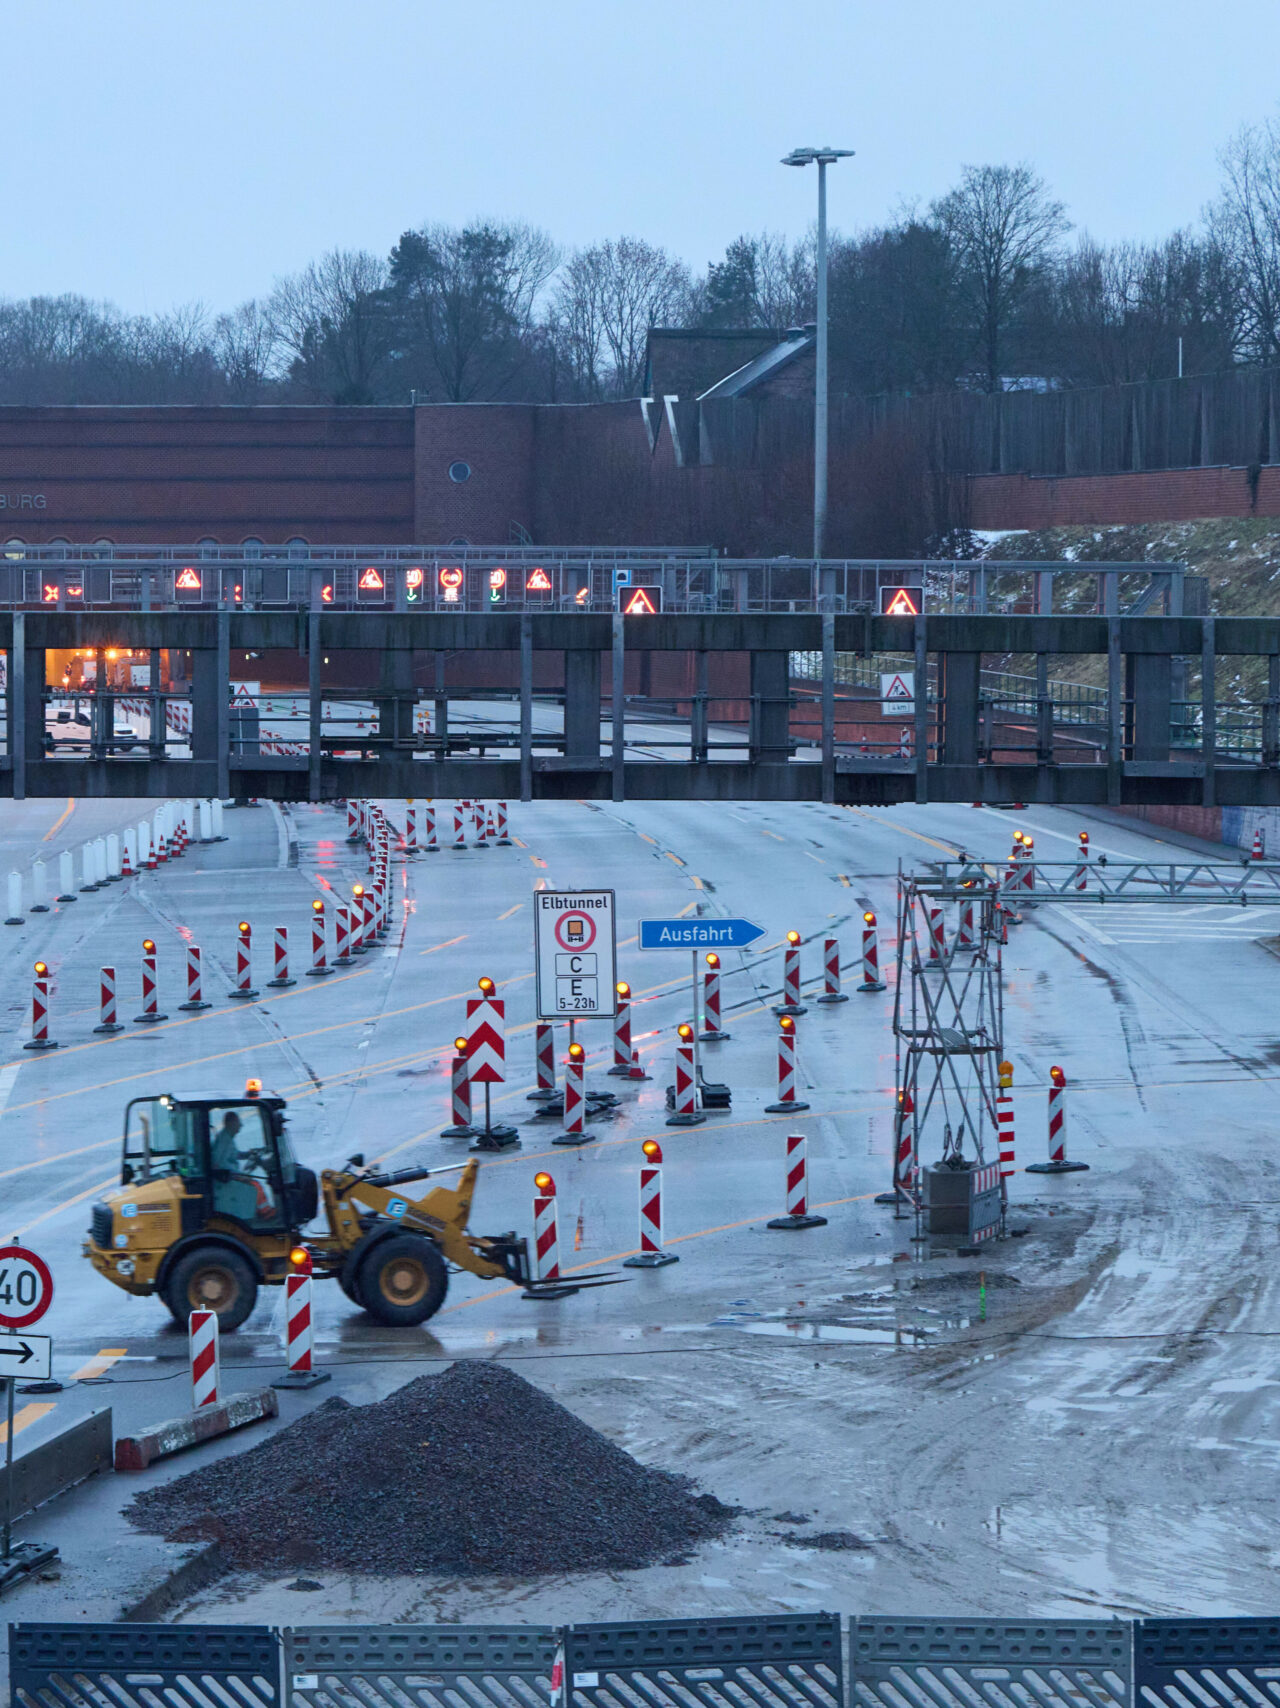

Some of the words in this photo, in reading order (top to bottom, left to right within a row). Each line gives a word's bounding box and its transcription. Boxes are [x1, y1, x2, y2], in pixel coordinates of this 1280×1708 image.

[542, 896, 608, 910] Elbtunnel
[659, 926, 733, 942] Ausfahrt
[570, 956, 583, 974] C
[571, 979, 583, 996] E
[559, 998, 596, 1009] 5-23h
